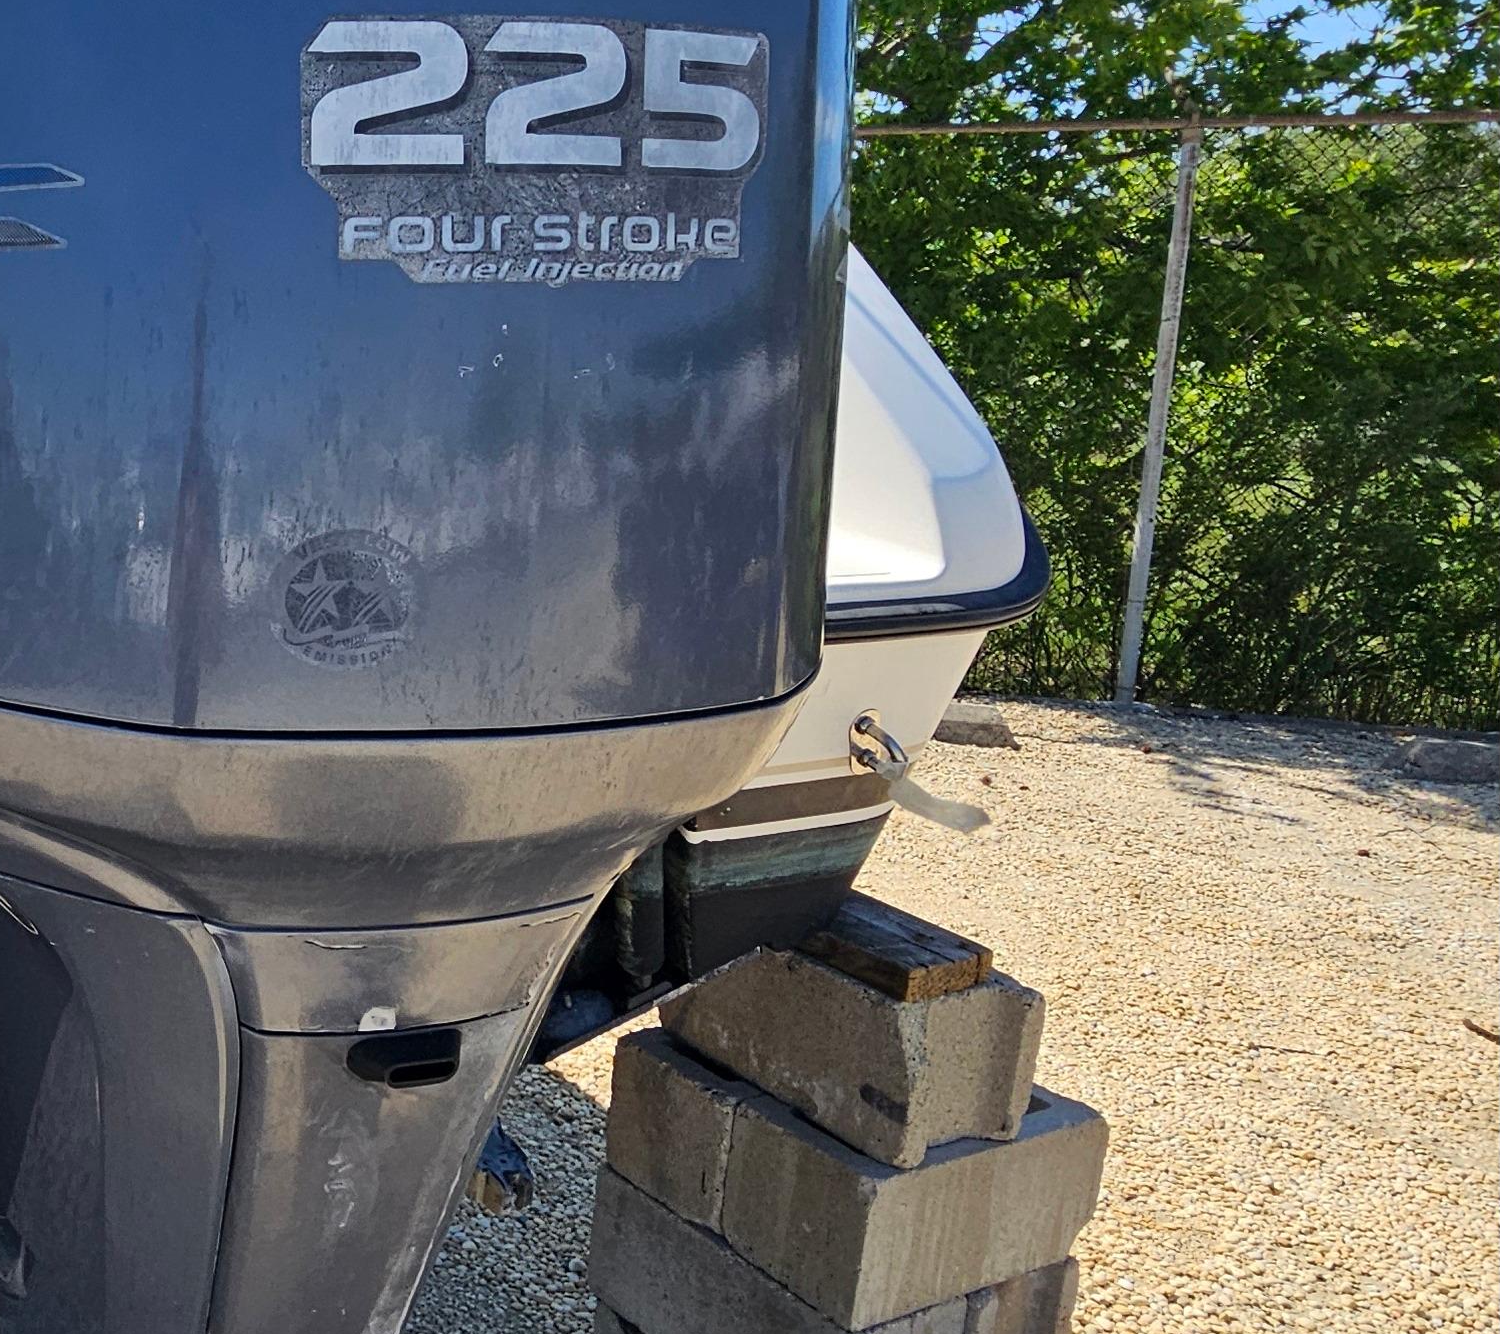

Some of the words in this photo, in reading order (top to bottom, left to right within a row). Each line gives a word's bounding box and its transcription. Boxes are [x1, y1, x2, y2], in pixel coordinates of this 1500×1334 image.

[306, 19, 762, 172] 225
[421, 257, 511, 281] Fuel
[522, 256, 687, 288] Injection
